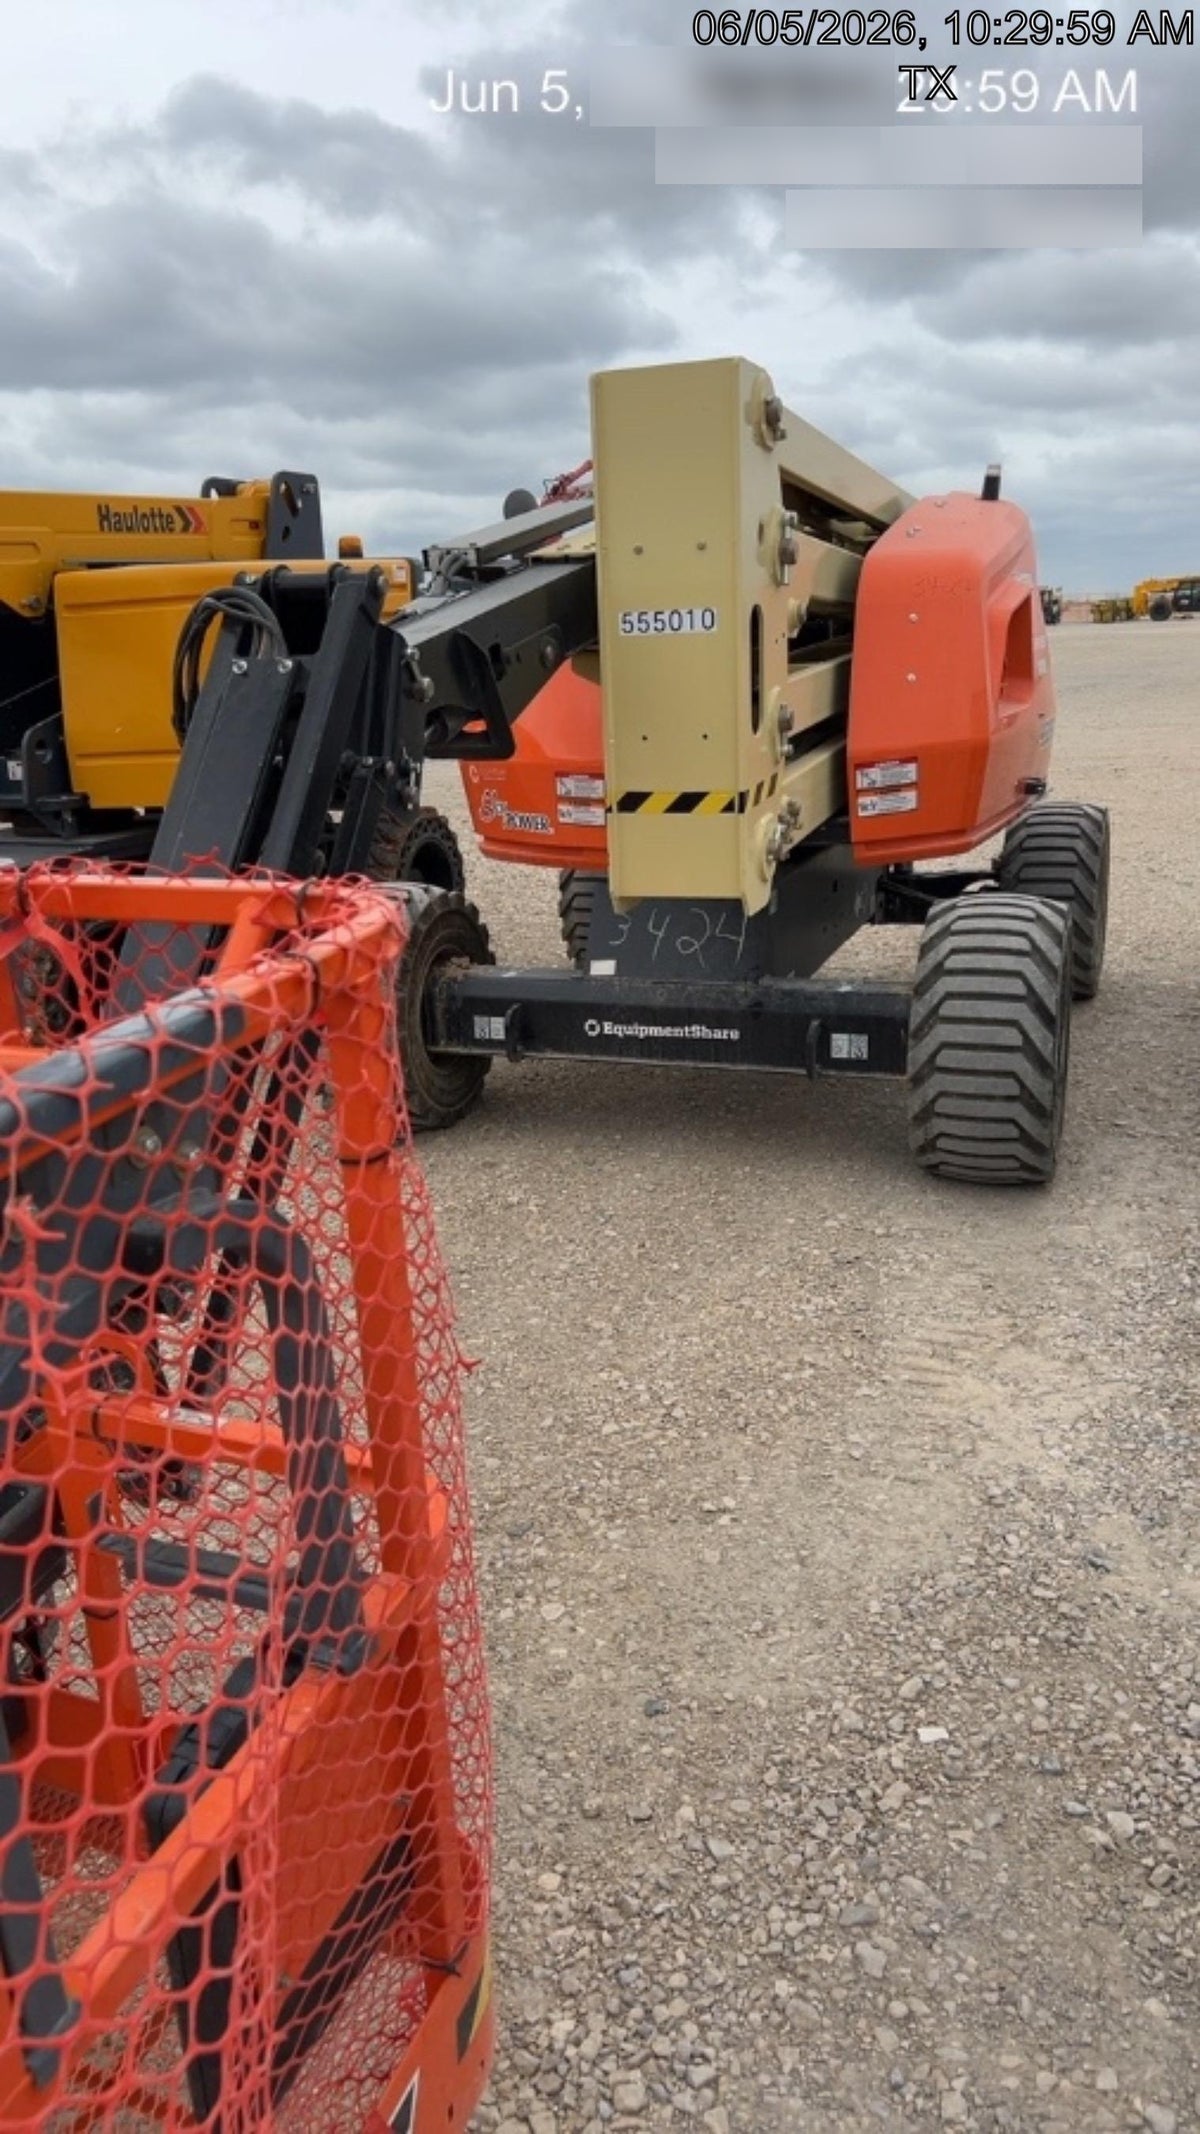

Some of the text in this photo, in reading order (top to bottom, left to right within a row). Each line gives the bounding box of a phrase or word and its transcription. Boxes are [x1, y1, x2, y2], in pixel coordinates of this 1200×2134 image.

[96, 503, 176, 533] Haulotte
[620, 607, 715, 634] 555010
[608, 905, 748, 969] 3424
[602, 1020, 741, 1041] EquipmentShare
